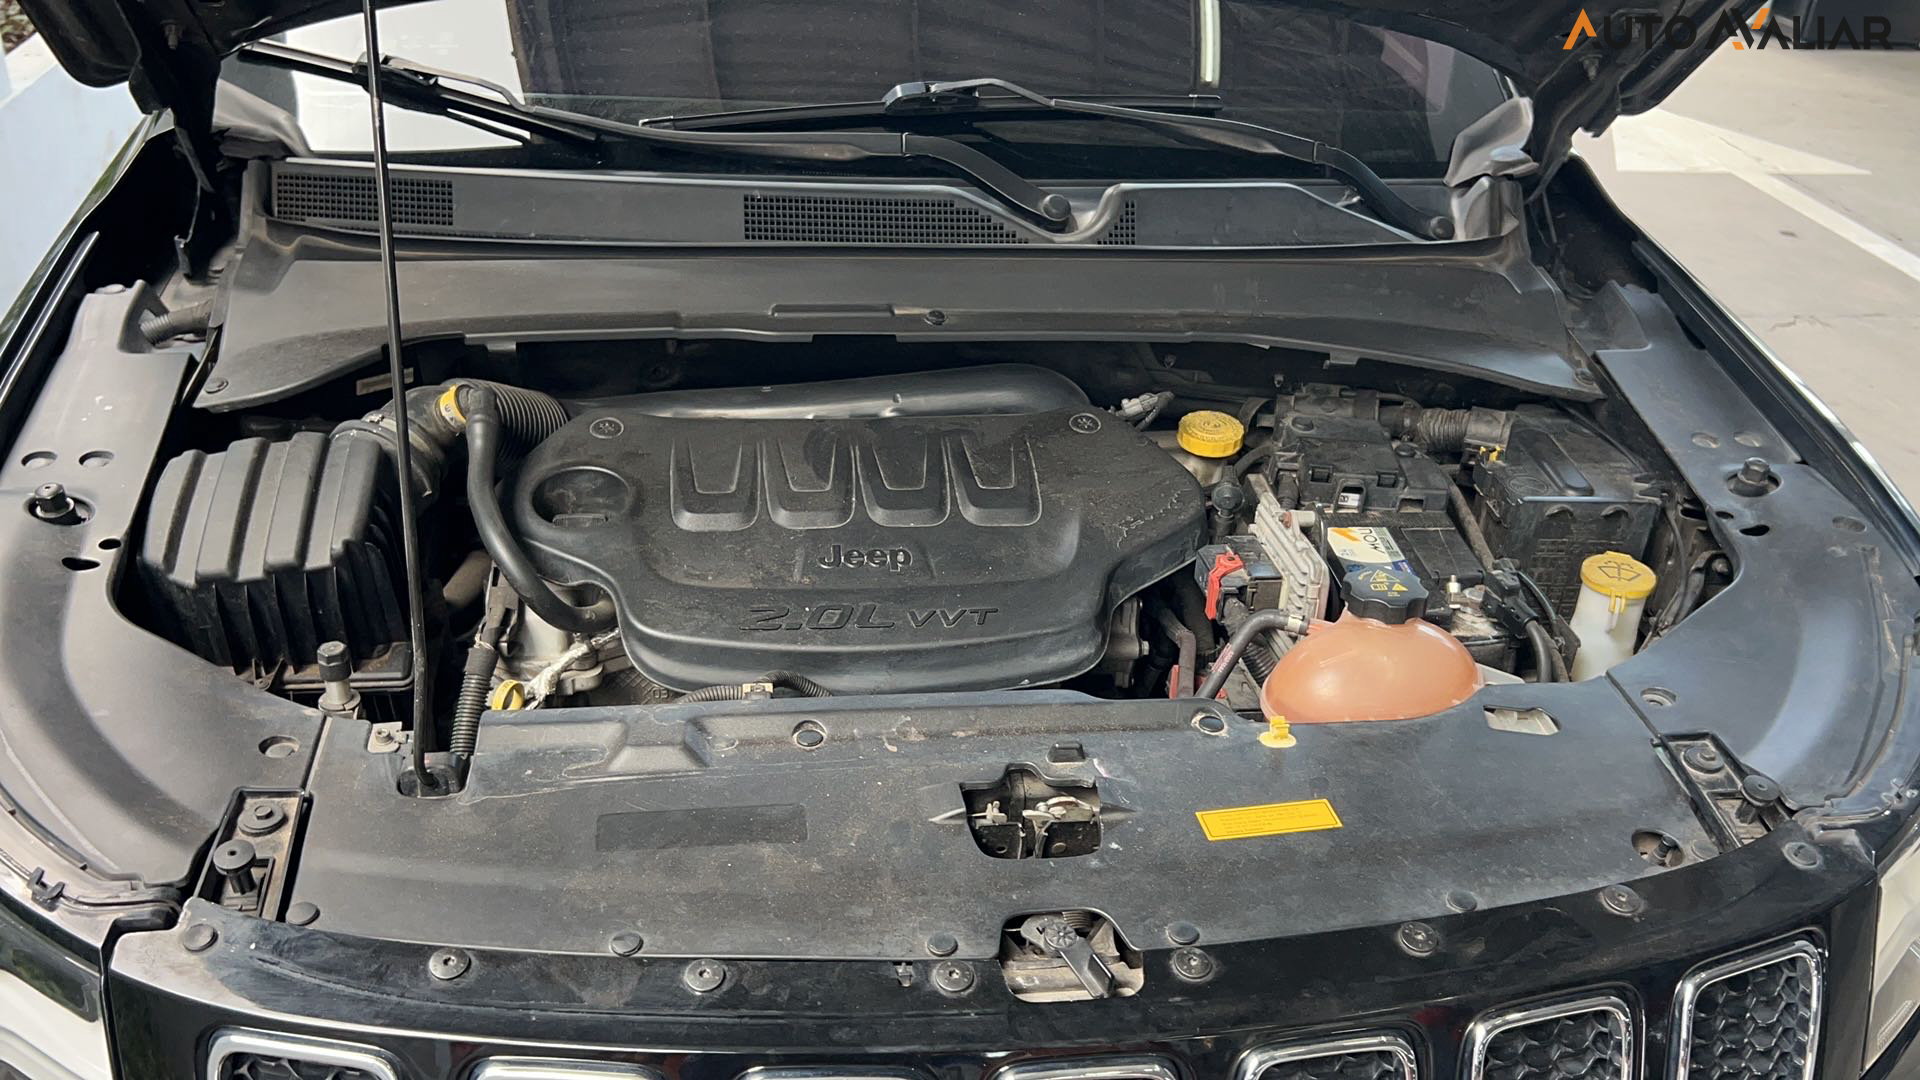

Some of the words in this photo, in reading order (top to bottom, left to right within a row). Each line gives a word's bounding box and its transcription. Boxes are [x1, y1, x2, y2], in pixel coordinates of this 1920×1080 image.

[817, 544, 913, 572] Jeep
[738, 604, 896, 632] 2.0L
[906, 607, 999, 629] VVT
